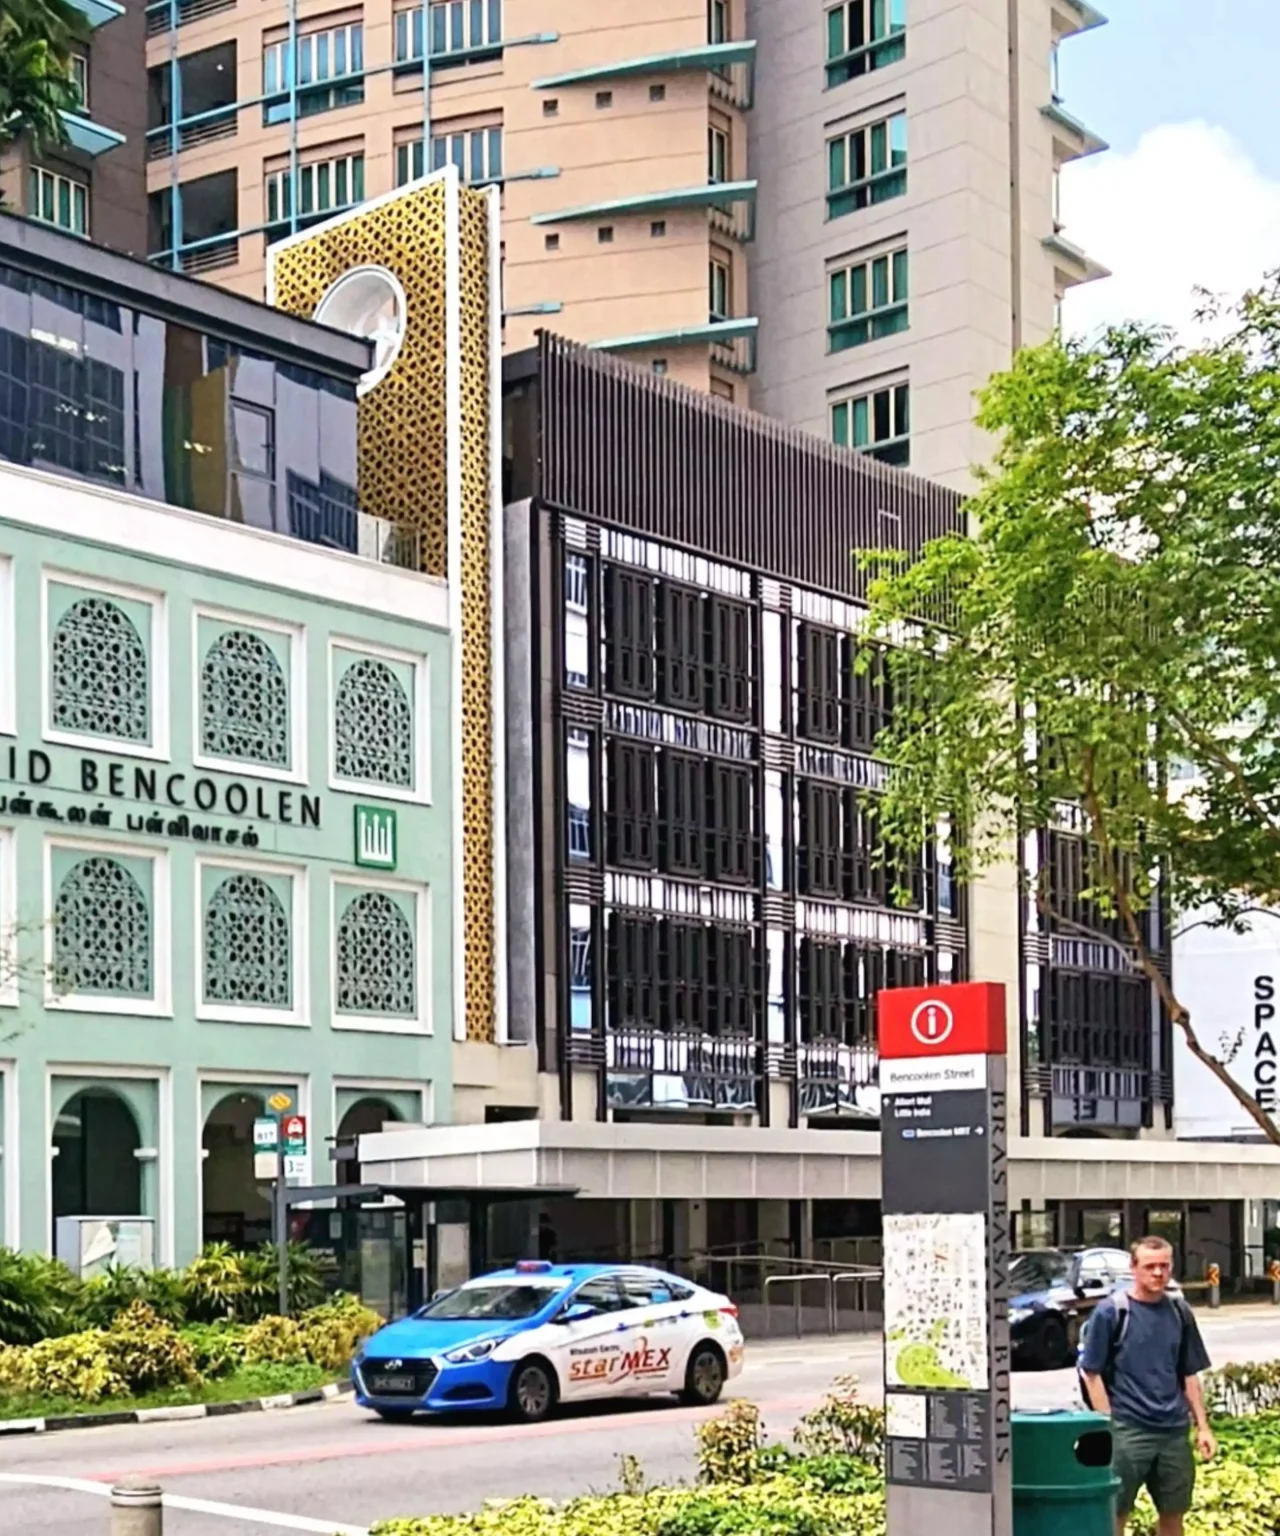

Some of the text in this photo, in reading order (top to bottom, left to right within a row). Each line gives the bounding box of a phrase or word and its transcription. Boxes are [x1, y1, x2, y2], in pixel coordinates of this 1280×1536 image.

[81, 758, 321, 827] BENCOOLEN
[943, 1068, 975, 1080] Street
[991, 1090, 1007, 1185] BRAS
